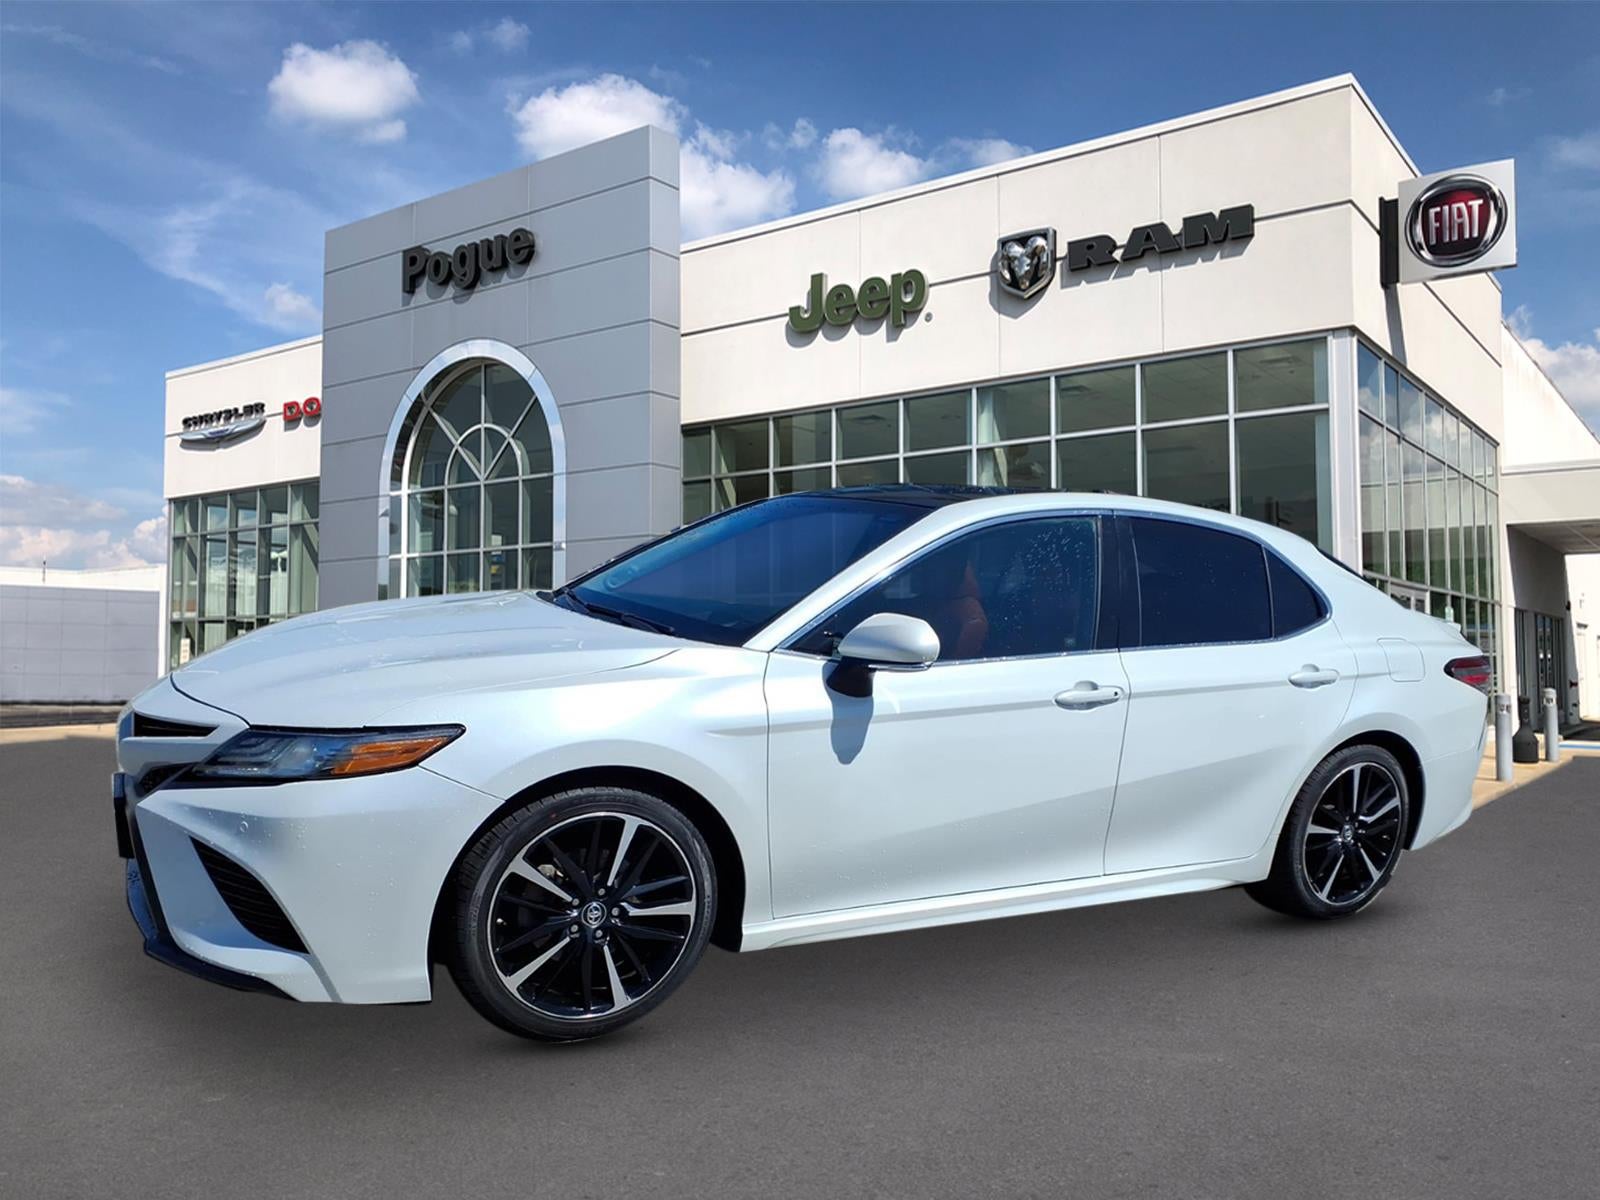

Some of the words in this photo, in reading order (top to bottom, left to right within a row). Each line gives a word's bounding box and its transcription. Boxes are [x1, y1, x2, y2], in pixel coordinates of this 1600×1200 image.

[1067, 203, 1255, 272] RAM
[1428, 199, 1484, 246] FIAT
[402, 227, 535, 294] Pogue
[789, 268, 928, 333] Jeep
[182, 402, 265, 428] CHRYSLER
